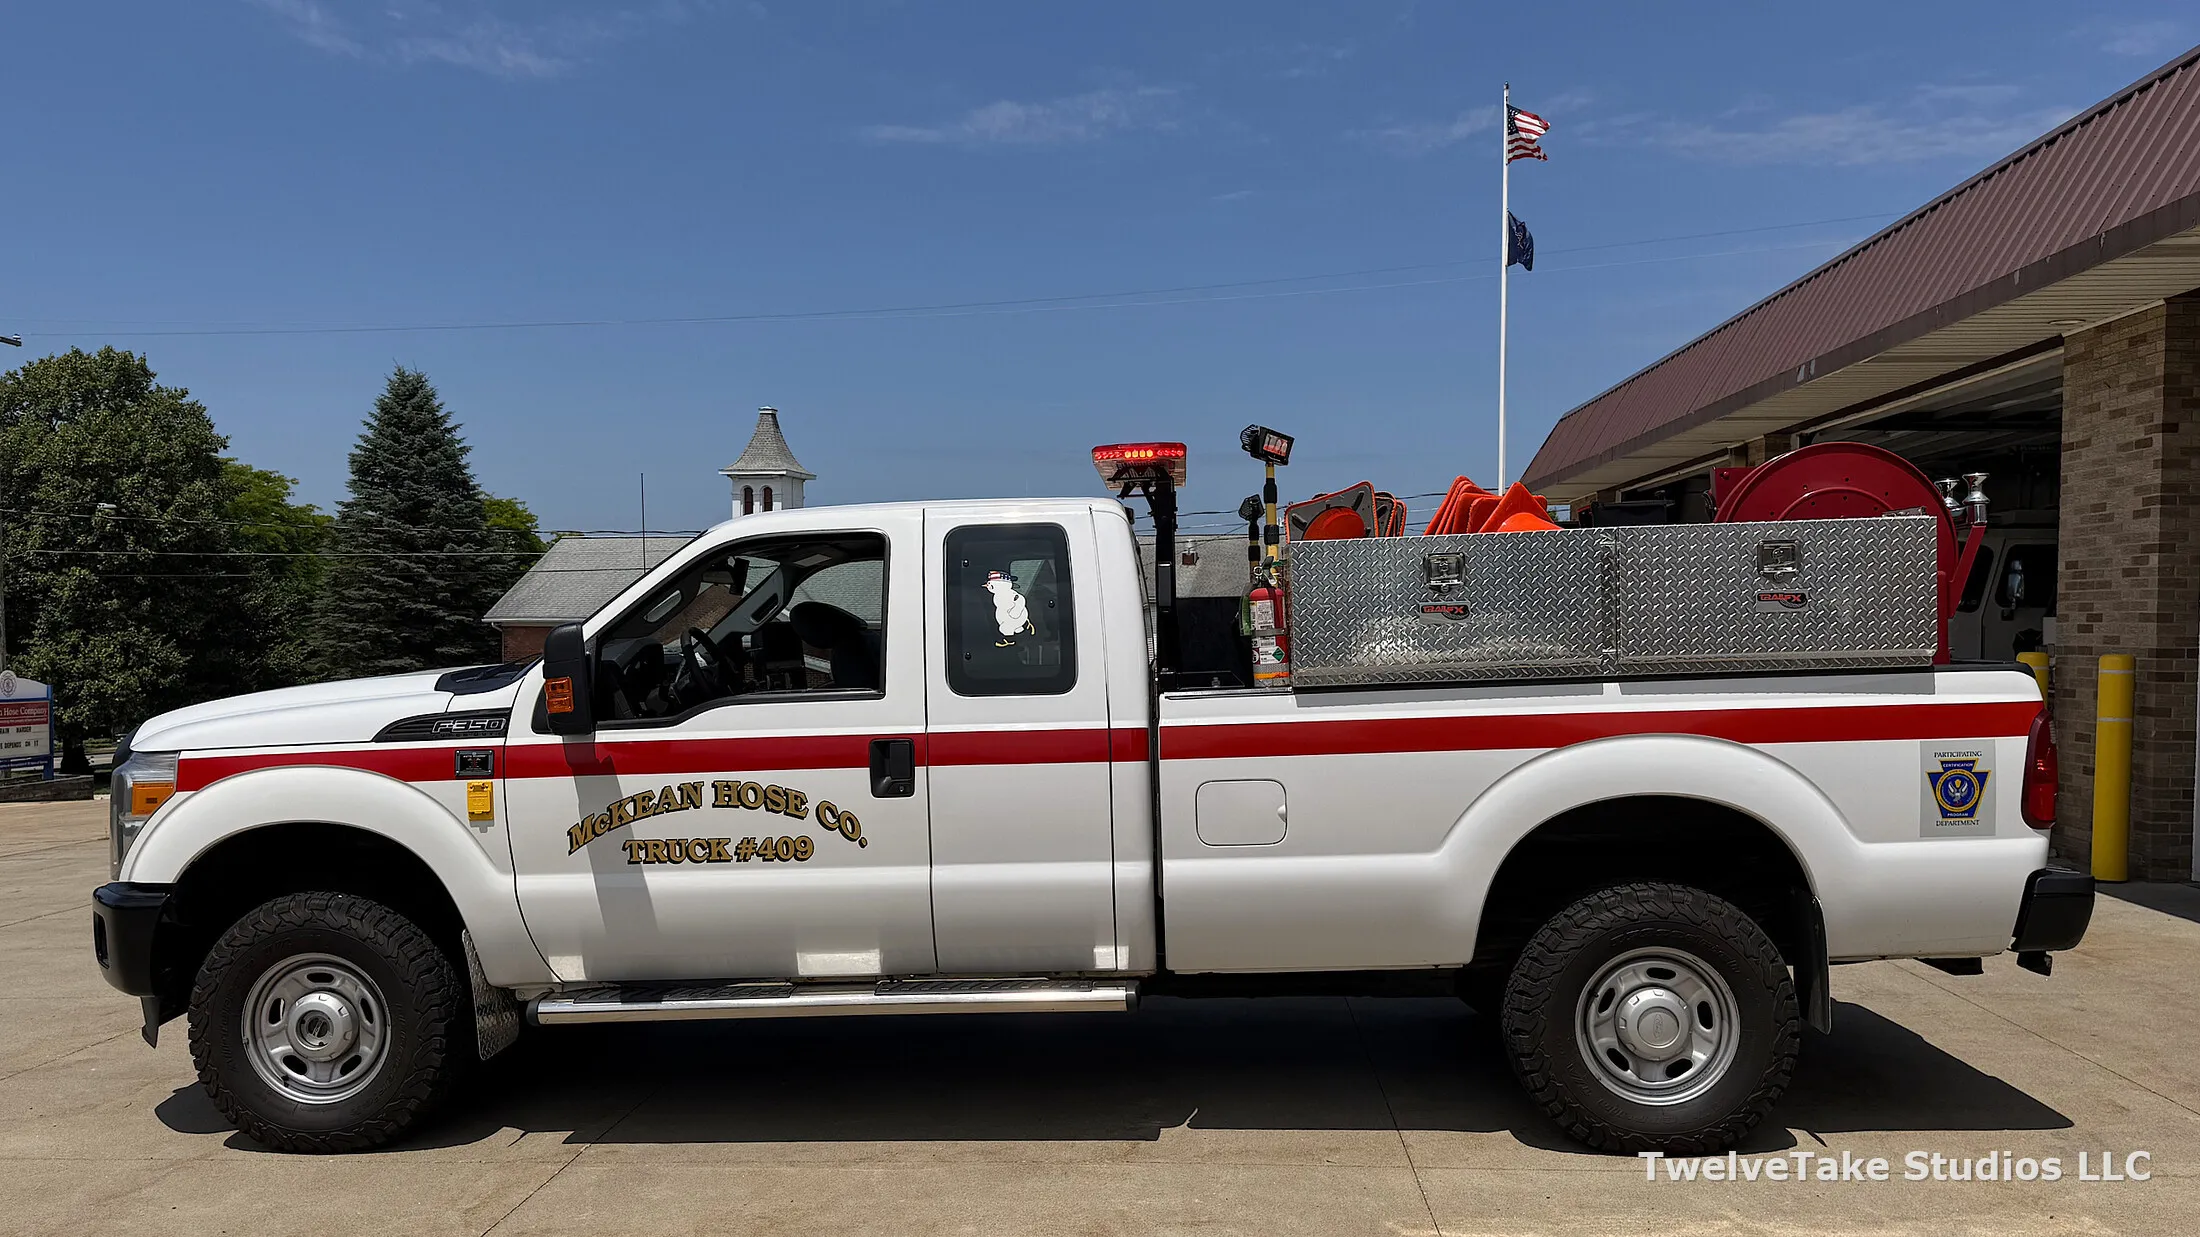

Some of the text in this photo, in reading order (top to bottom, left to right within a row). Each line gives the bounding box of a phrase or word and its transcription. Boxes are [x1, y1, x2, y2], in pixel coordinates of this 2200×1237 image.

[4, 707, 19, 716] Hose
[20, 706, 47, 716] Company
[1933, 750, 1982, 758] PARTICIPATING
[711, 780, 810, 820] HOSE
[815, 800, 867, 848] CO.
[1935, 819, 1980, 827] DEPARTMENT
[622, 835, 815, 865] TRUCK #409
